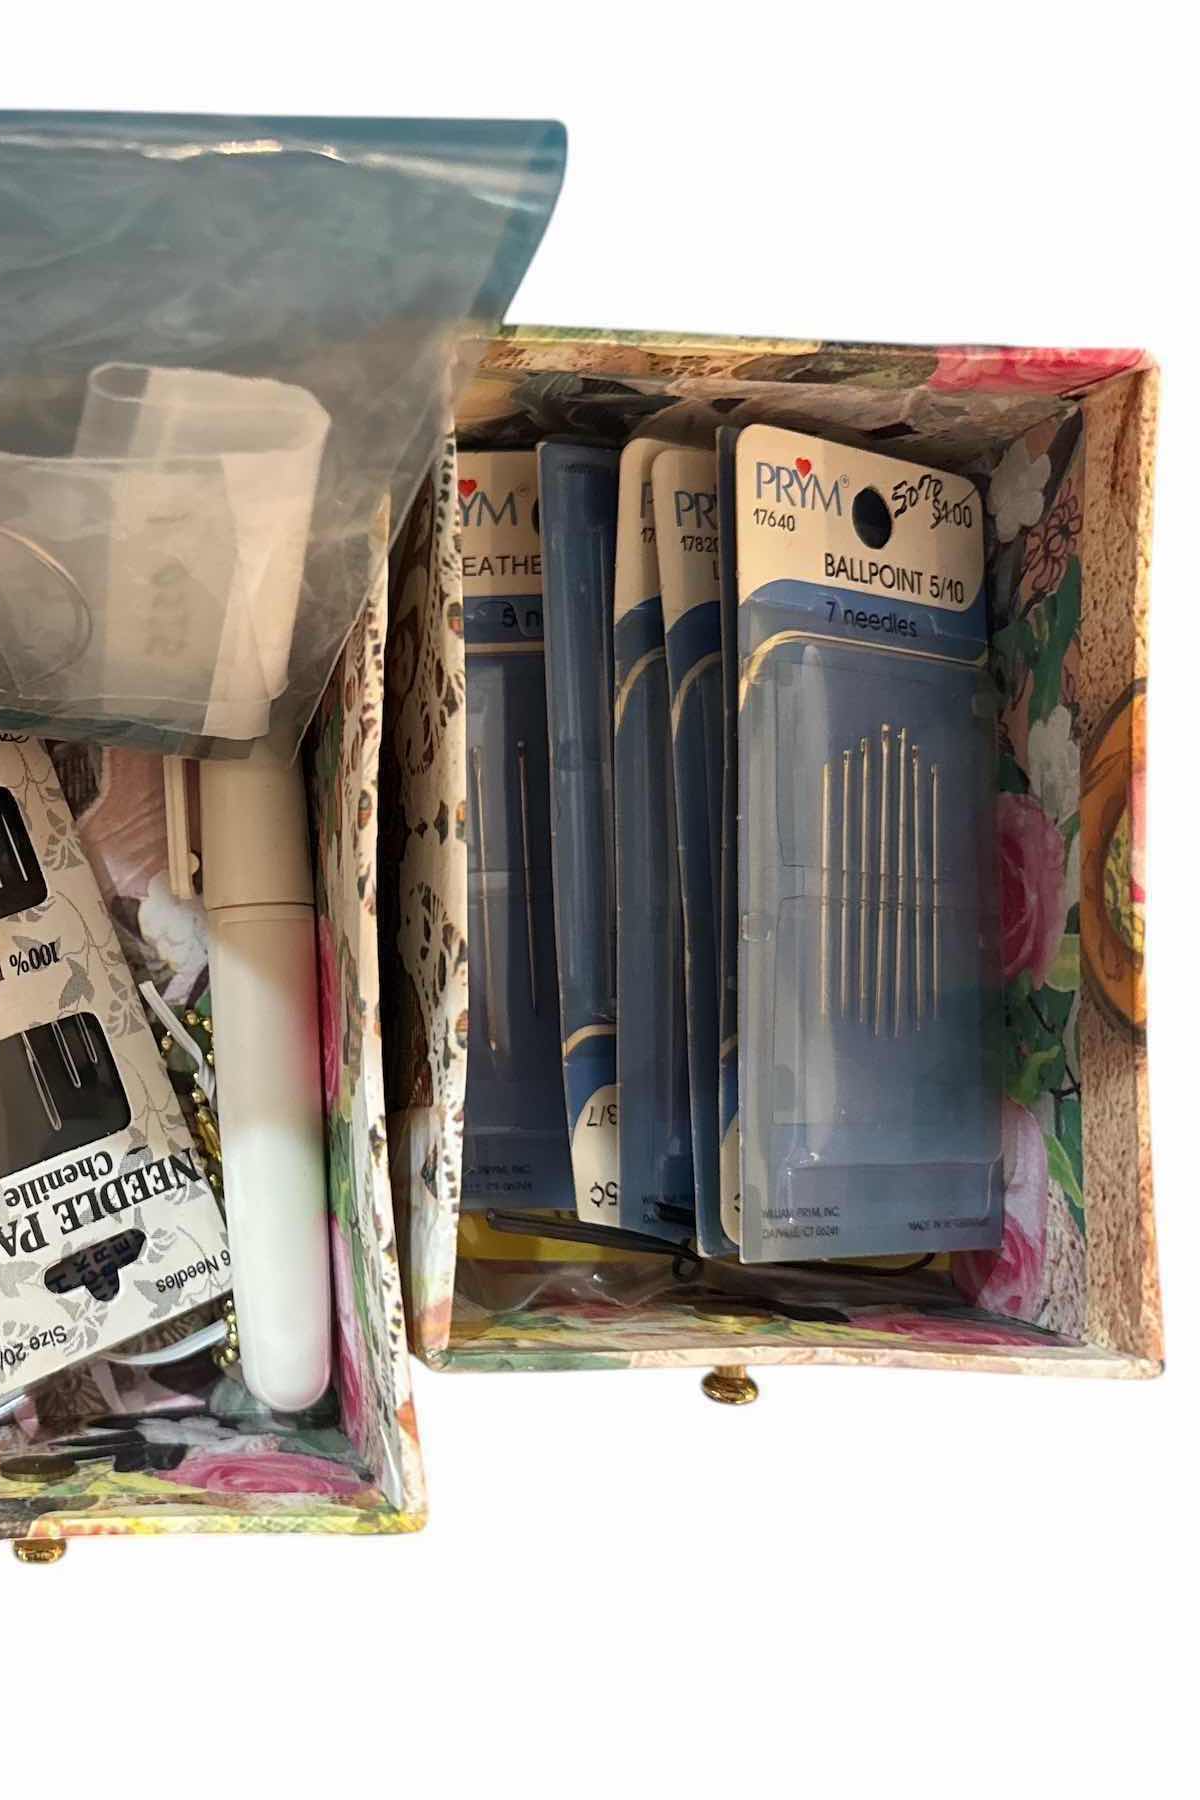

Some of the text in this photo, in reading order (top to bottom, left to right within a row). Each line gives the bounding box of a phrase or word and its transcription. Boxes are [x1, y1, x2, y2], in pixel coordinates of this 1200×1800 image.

[753, 508, 796, 532] 17640
[462, 554, 542, 577] EATHE
[824, 552, 965, 604] BALLPOINT 5/10
[826, 601, 919, 638] 7 needles
[9, 941, 61, 976] 100%
[3, 1151, 114, 1208] Chenille
[52, 1147, 202, 1236] NEEDLE
[155, 1249, 232, 1294] 6 Needles
[29, 1325, 68, 1351] Size
